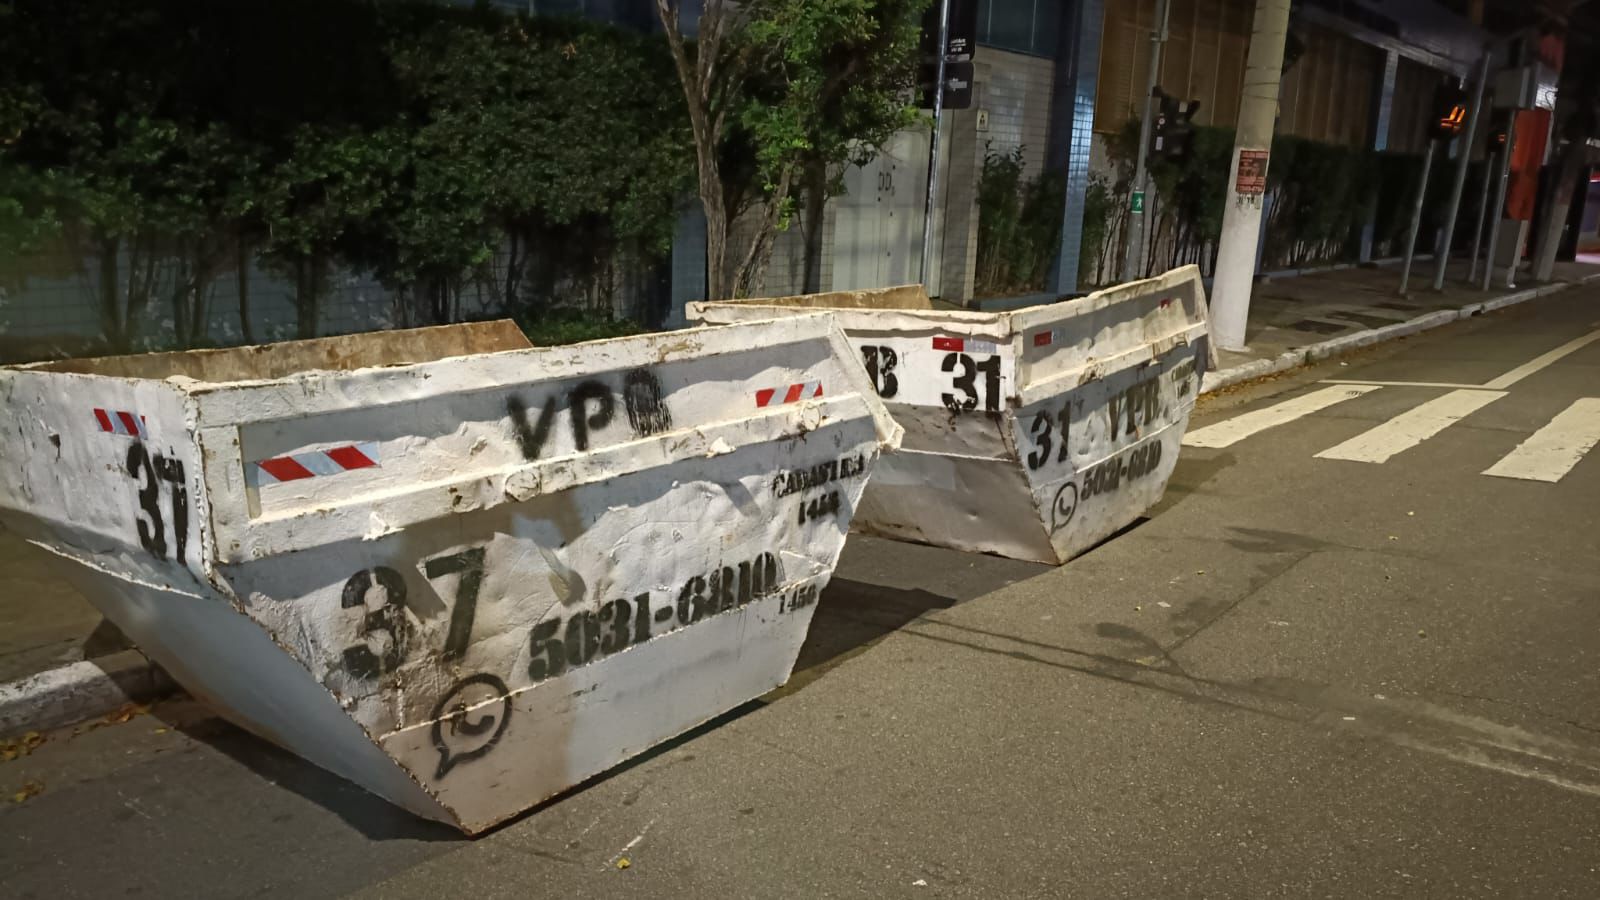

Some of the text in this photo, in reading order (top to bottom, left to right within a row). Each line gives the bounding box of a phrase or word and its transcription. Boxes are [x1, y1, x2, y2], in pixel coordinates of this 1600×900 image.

[941, 351, 1002, 416] 31
[1028, 400, 1071, 470] 31
[126, 437, 188, 568] 37
[341, 546, 486, 679] 37
[528, 551, 778, 682] 5031-6810
